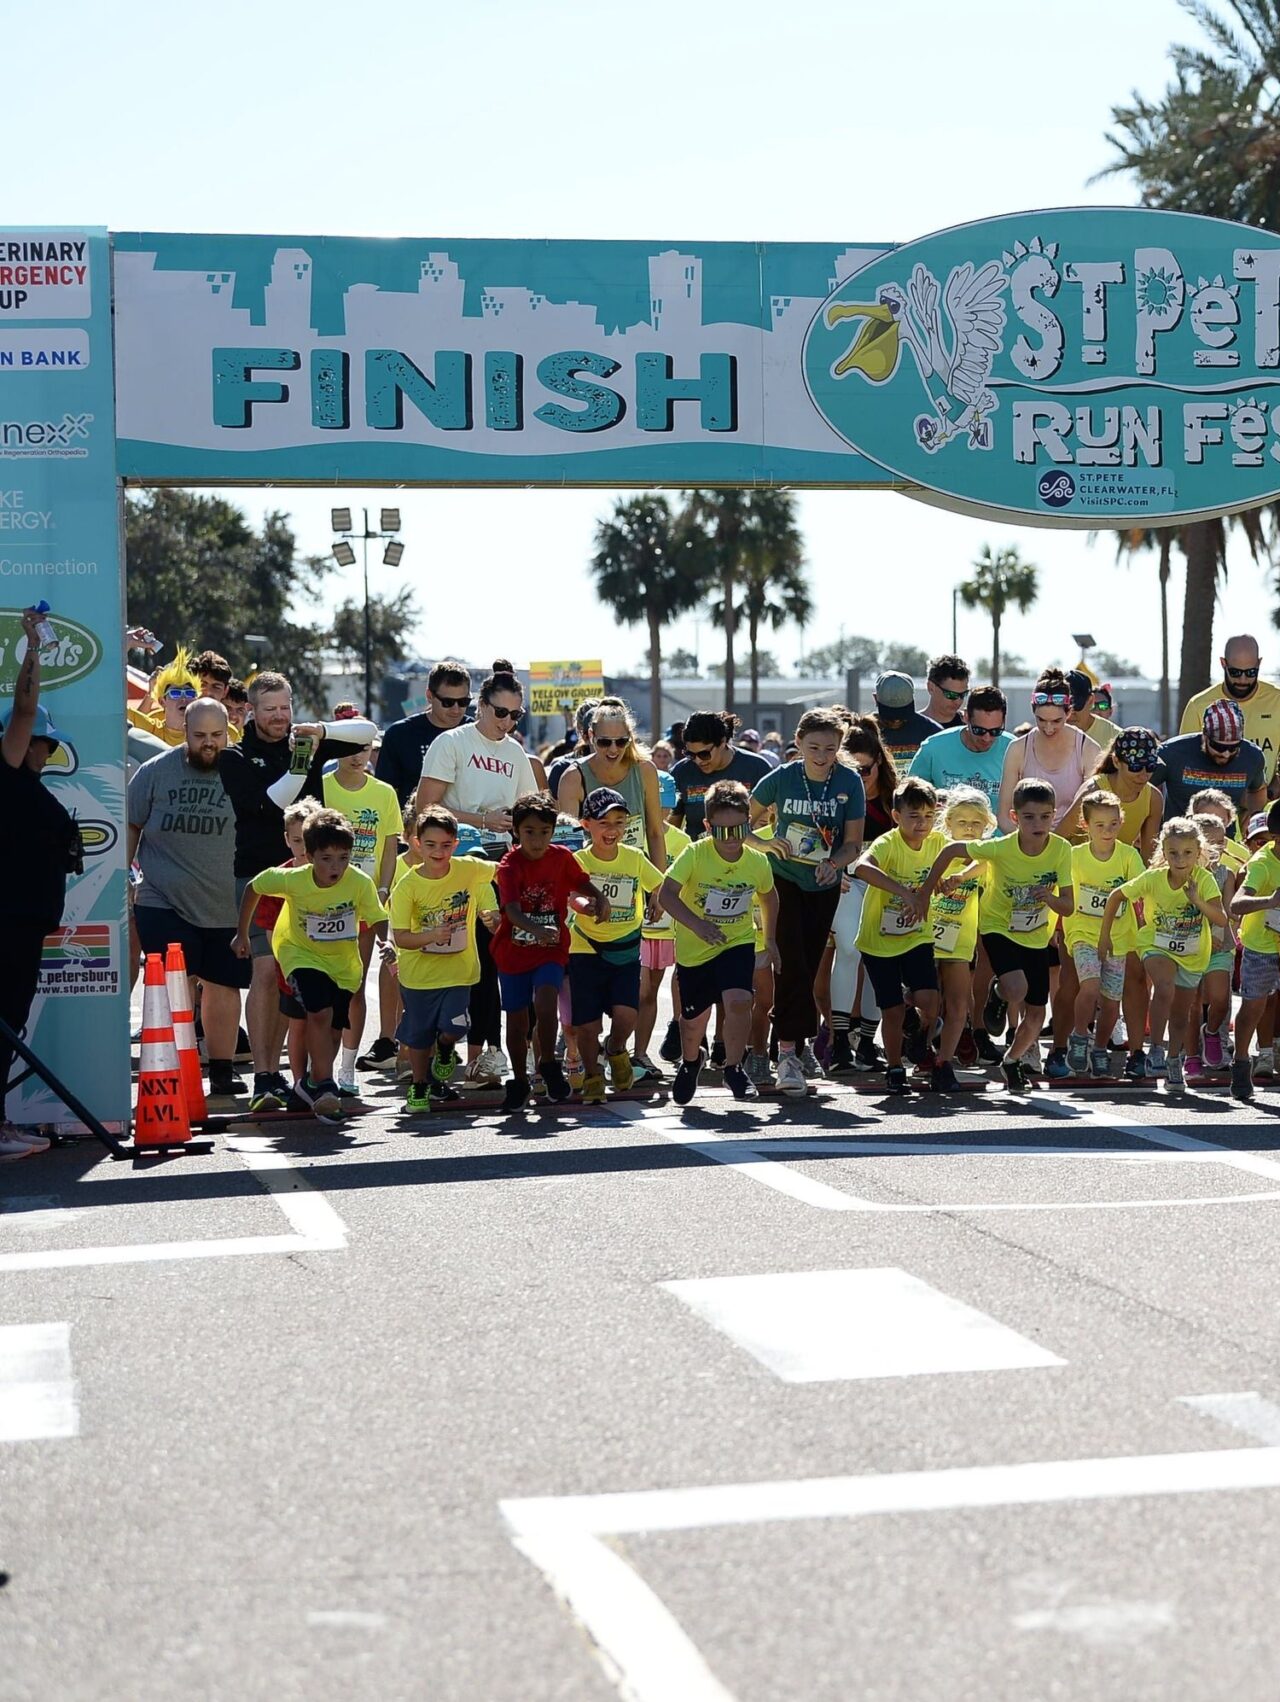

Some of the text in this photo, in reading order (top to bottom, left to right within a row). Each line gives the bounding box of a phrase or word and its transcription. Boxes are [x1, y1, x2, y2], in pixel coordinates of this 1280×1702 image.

[21, 350, 81, 366] BANK
[212, 348, 739, 432] FINISH
[1012, 401, 1162, 468] RUN
[1079, 473, 1125, 482] ST.PETE
[1079, 497, 1149, 507] VisitSPC.com
[532, 688, 569, 699] YELLOW
[532, 700, 553, 713] ONE
[168, 787, 227, 809] PEOPLE
[161, 813, 228, 836] DADDY
[602, 883, 619, 898] 80
[721, 897, 740, 910] 97
[1091, 895, 1108, 909] 84
[317, 919, 346, 933] 220
[1025, 913, 1040, 926] 71
[1168, 940, 1185, 953] 95
[140, 1078, 179, 1096] NXT
[143, 1104, 180, 1122] LVL
